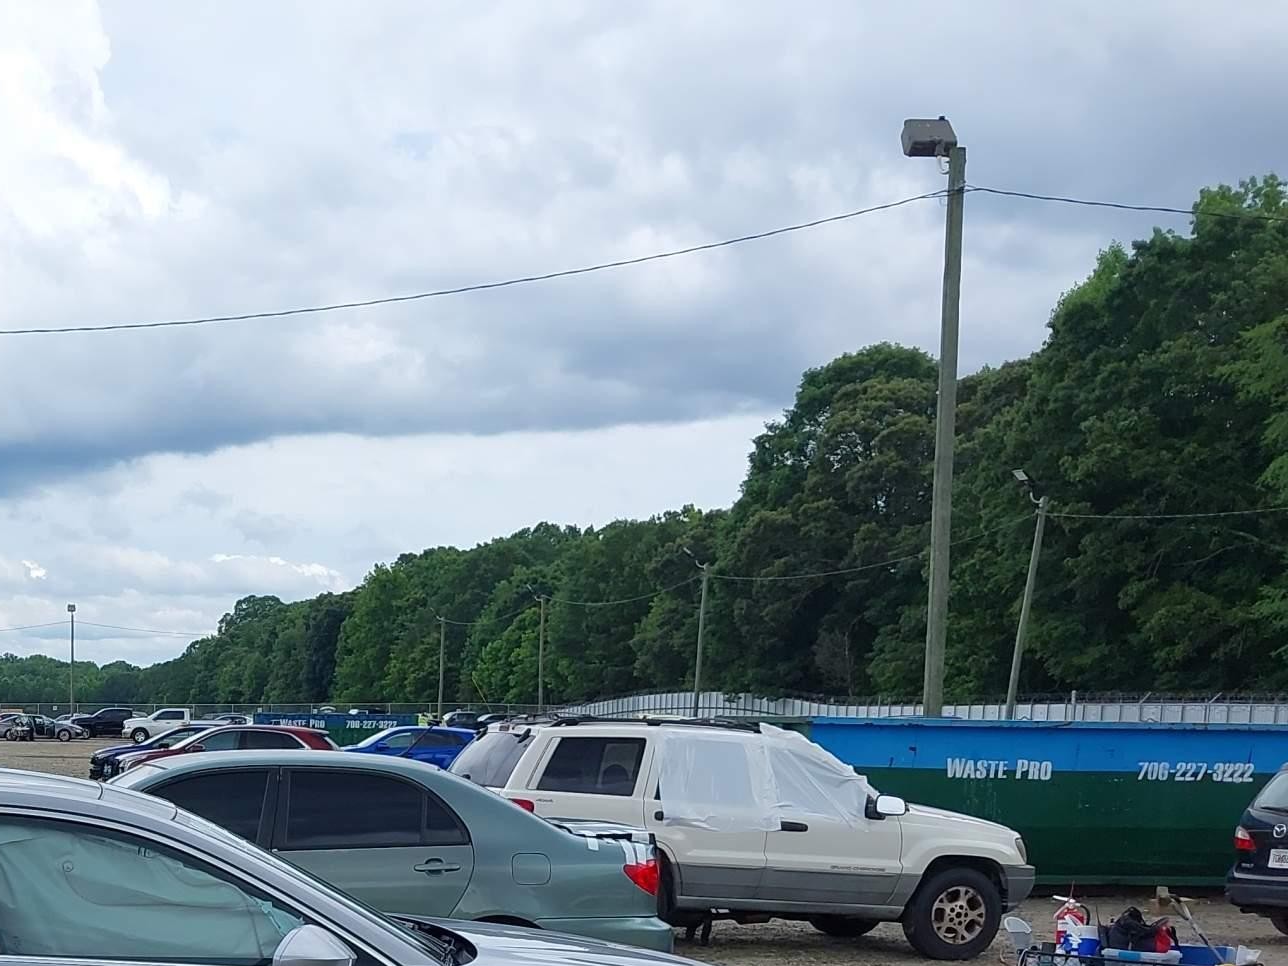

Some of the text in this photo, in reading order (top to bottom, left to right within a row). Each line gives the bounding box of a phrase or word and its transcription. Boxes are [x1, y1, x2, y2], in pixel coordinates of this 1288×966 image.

[947, 758, 1052, 780] WASTE PRO
[1137, 762, 1254, 782] 706-227-3222
